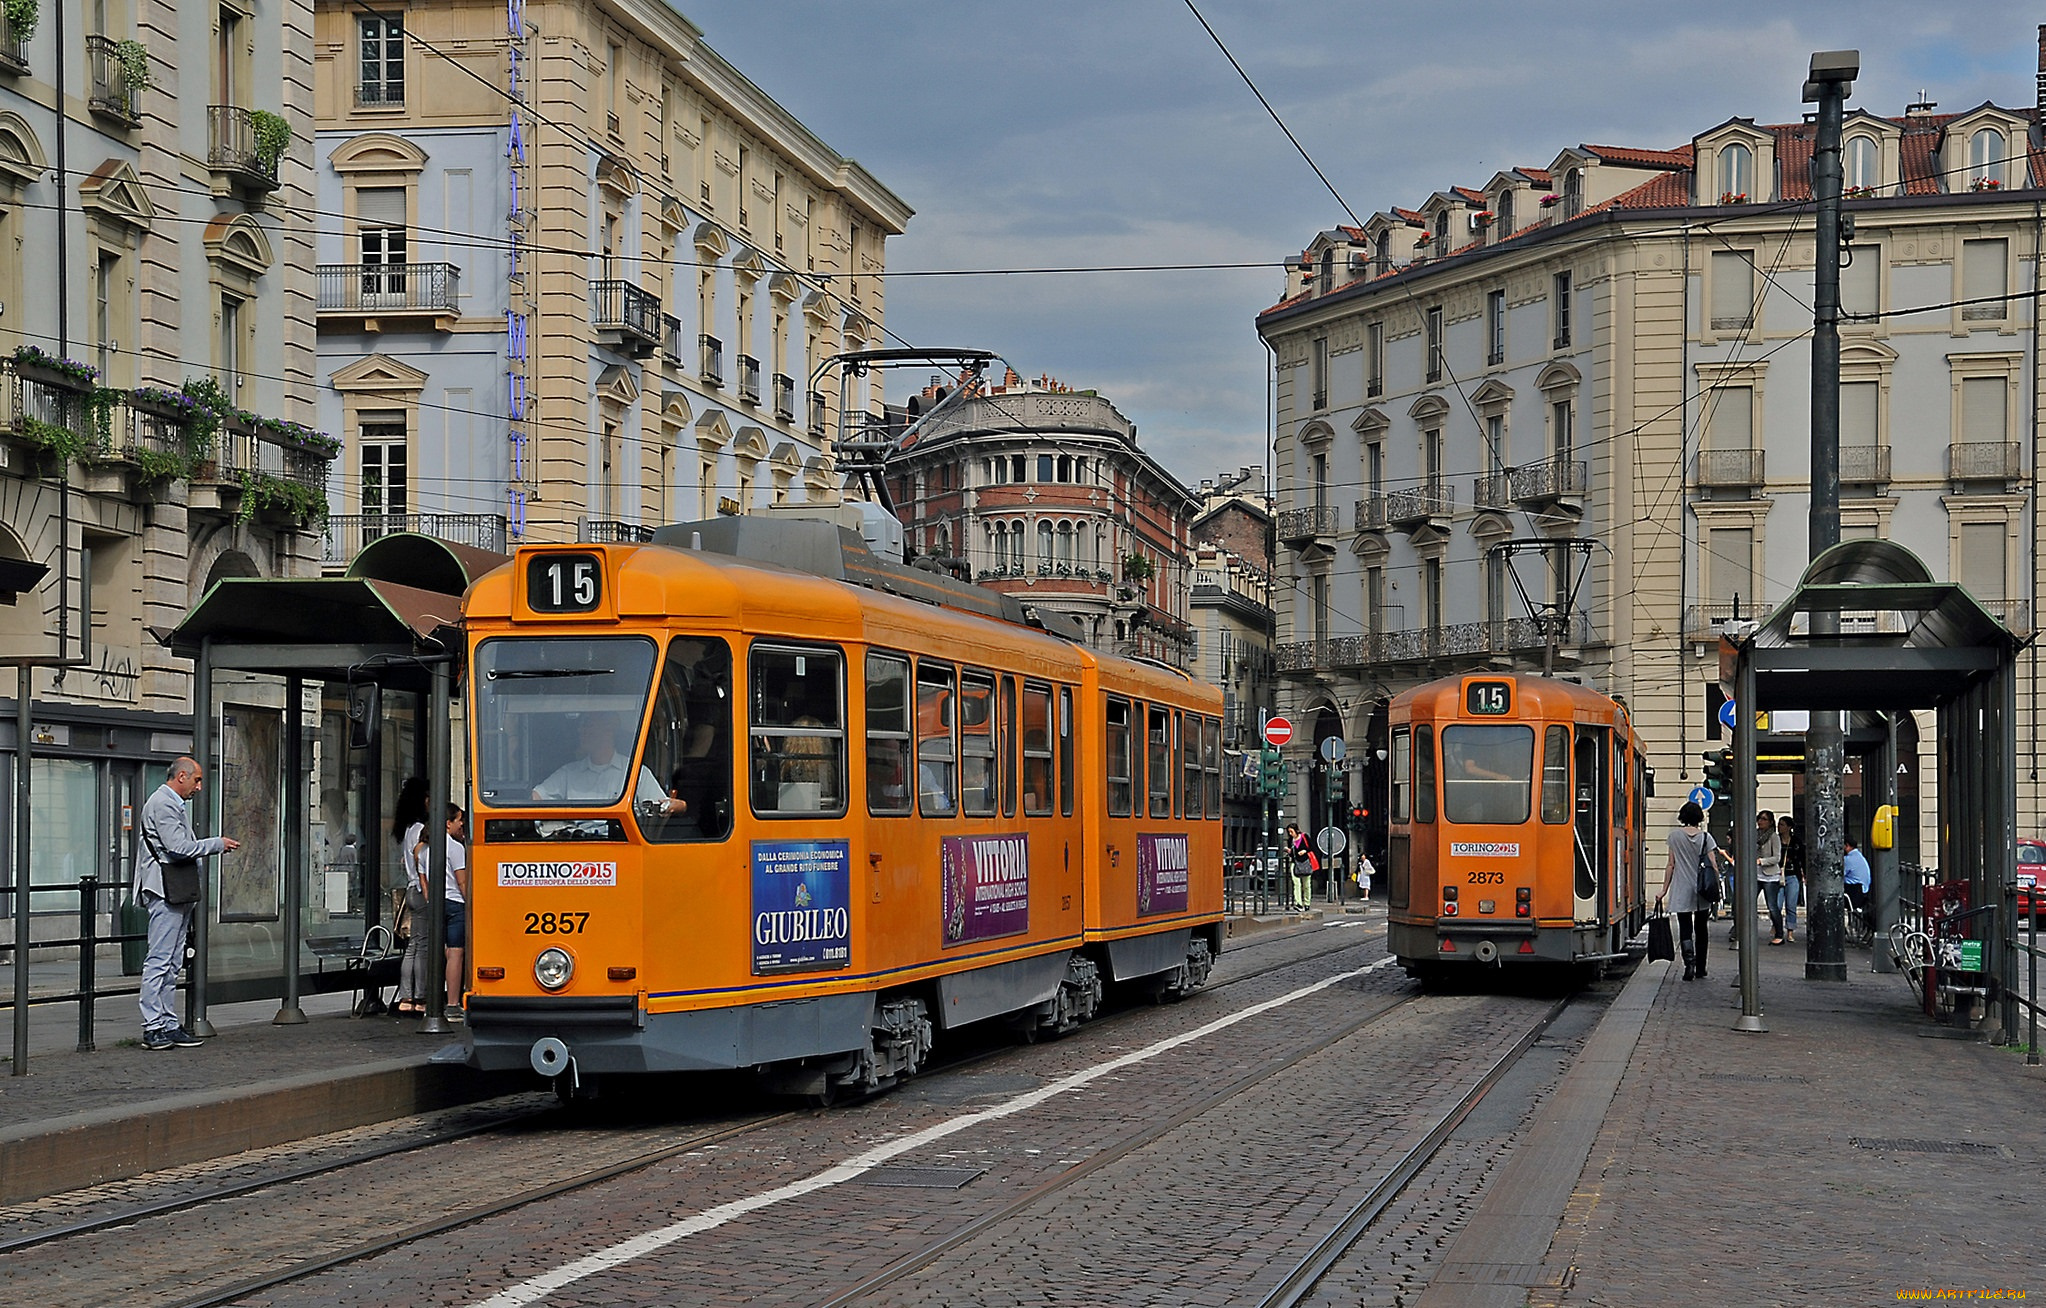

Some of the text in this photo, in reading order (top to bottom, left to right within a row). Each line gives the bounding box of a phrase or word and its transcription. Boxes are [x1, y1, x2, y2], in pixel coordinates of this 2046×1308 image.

[548, 563, 594, 605] 15
[1477, 687, 1504, 711] 15
[757, 852, 777, 862] DALLA
[972, 838, 1027, 884] VITTORIA
[1154, 838, 1187, 870] VITTORIA
[502, 863, 612, 878] TORINO2015
[765, 861, 839, 874] AL GRANDE RITO FUNEBRE
[1467, 871, 1505, 885] 2873
[524, 912, 590, 934] 2857
[755, 906, 848, 945] GIUBILEO
